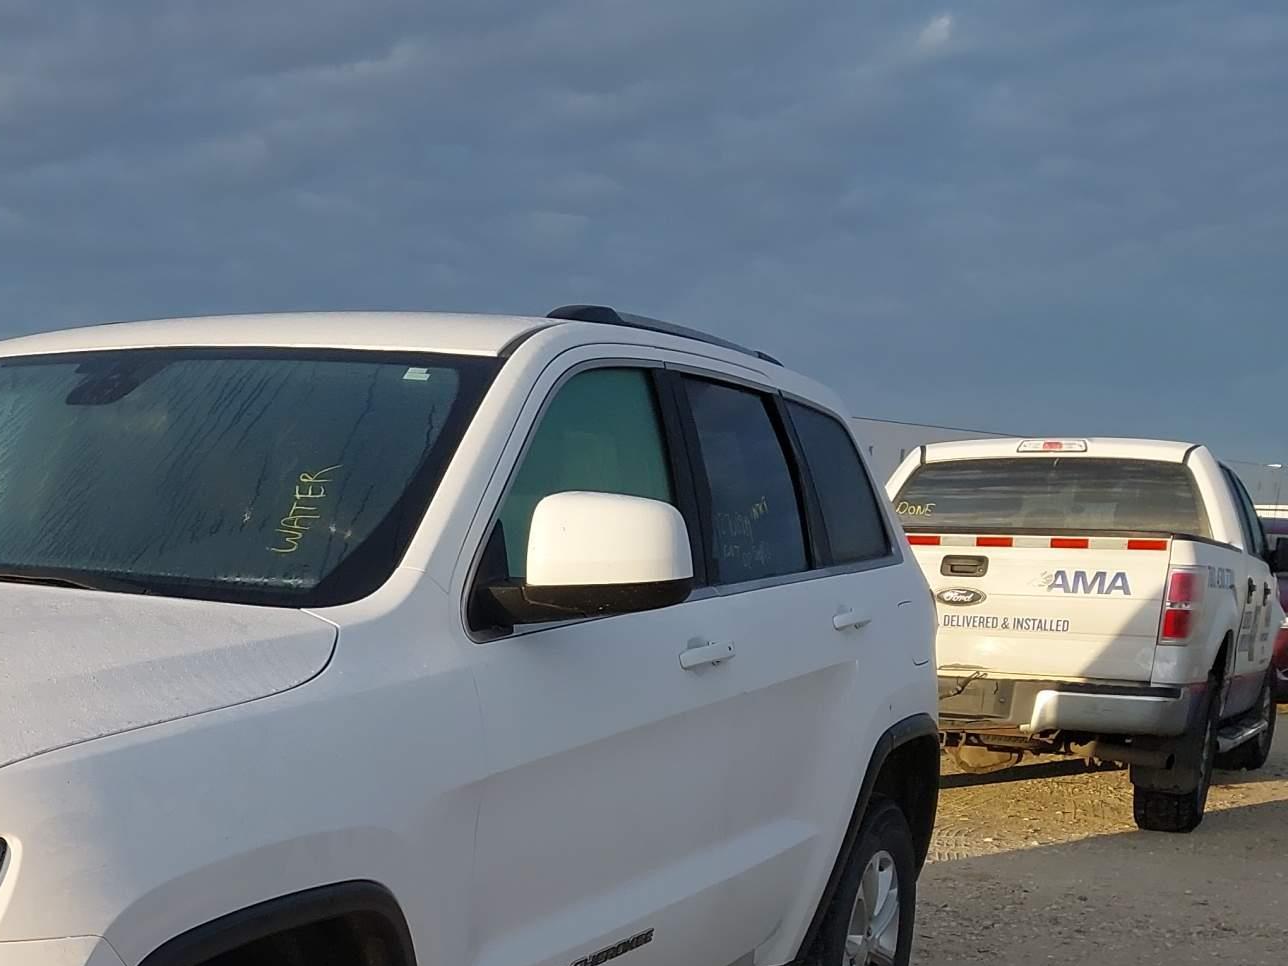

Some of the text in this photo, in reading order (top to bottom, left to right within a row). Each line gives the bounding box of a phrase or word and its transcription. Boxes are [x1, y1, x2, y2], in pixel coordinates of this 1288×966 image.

[266, 464, 344, 553] WATER
[1047, 569, 1132, 596] AMA
[943, 614, 1070, 633] DELIVERED & INSTALLED
